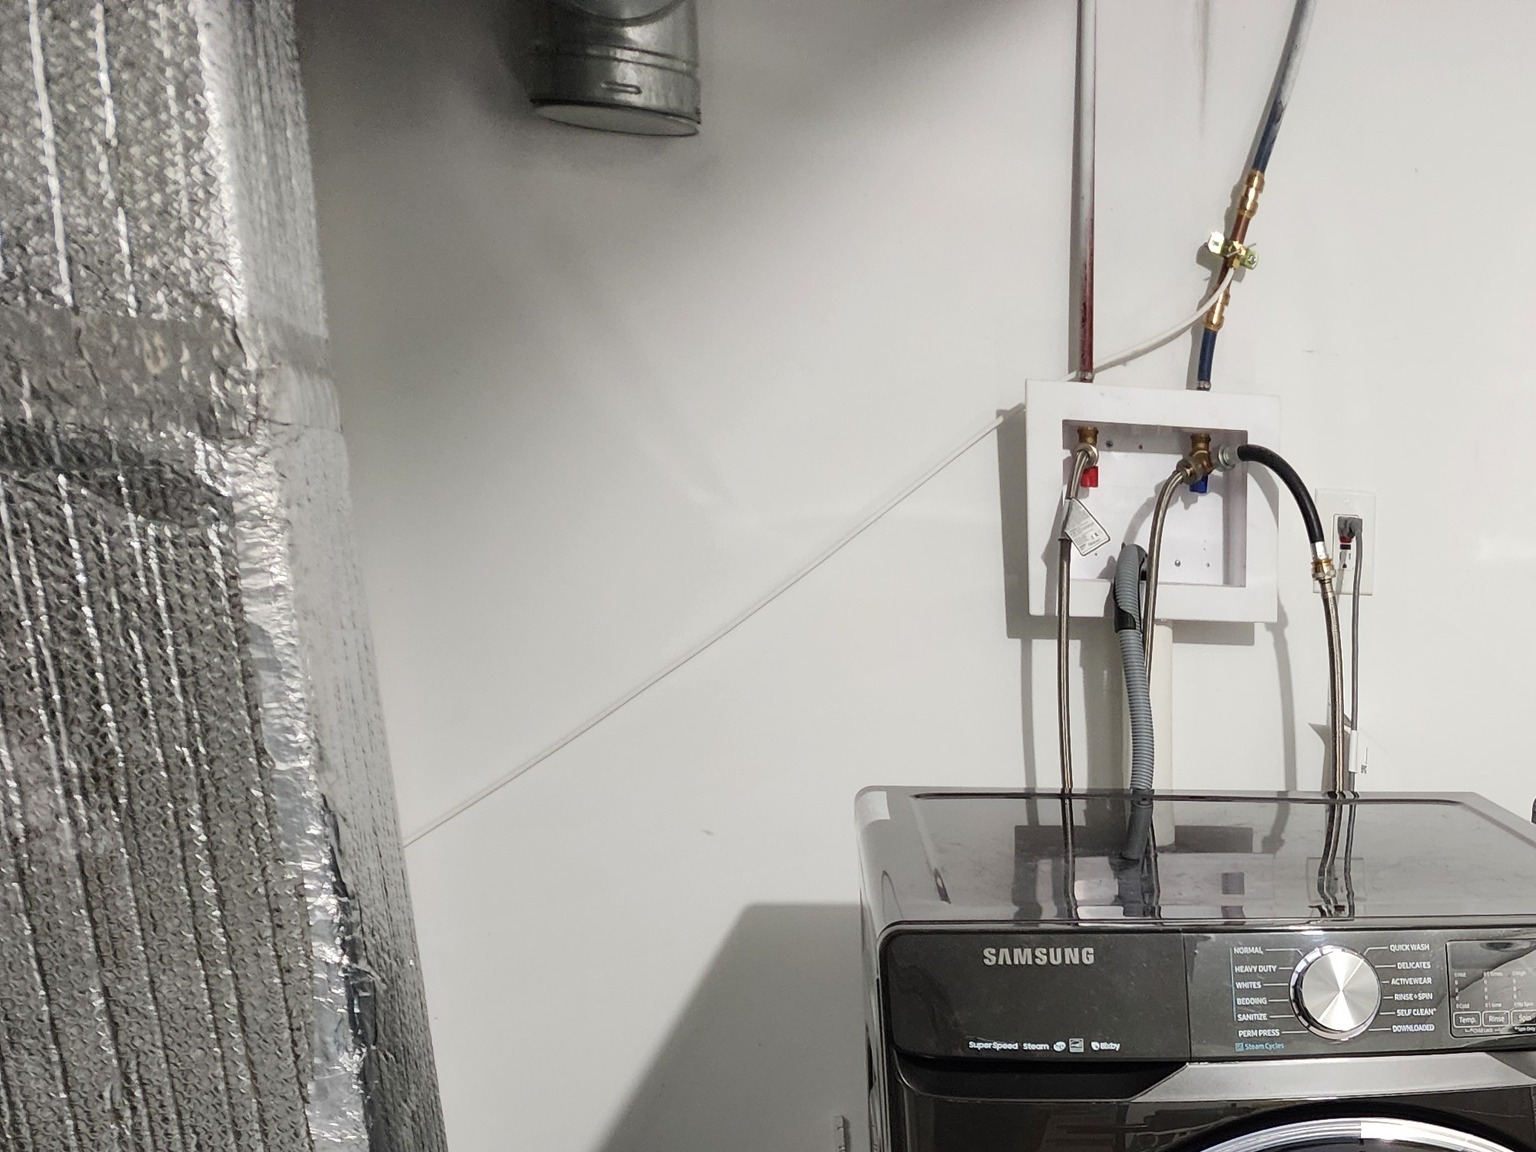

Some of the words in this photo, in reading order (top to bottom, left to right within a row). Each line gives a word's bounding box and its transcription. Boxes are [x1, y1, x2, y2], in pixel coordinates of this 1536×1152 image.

[1233, 947, 1264, 955] NORMAL
[1389, 944, 1410, 952] QUICK
[1410, 943, 1430, 951] WASH
[982, 947, 1095, 966] SAMSUNG
[1235, 965, 1257, 973] HEAVY
[1258, 965, 1277, 973] DUTY
[1397, 961, 1431, 969] DELICATES
[1391, 977, 1432, 985] ACTIVEWEAR
[1237, 1013, 1268, 1021] SANITIZE
[1396, 1009, 1411, 1017] SELF
[1459, 1016, 1477, 1024] Temp.
[1392, 1024, 1435, 1033] DOWNLOADED
[1238, 1030, 1258, 1038] PERM
[1259, 1029, 1280, 1037] PRESS
[1023, 1042, 1049, 1050] Steam
[1100, 1042, 1121, 1051] Bixby
[1265, 1042, 1285, 1050] Cycles
